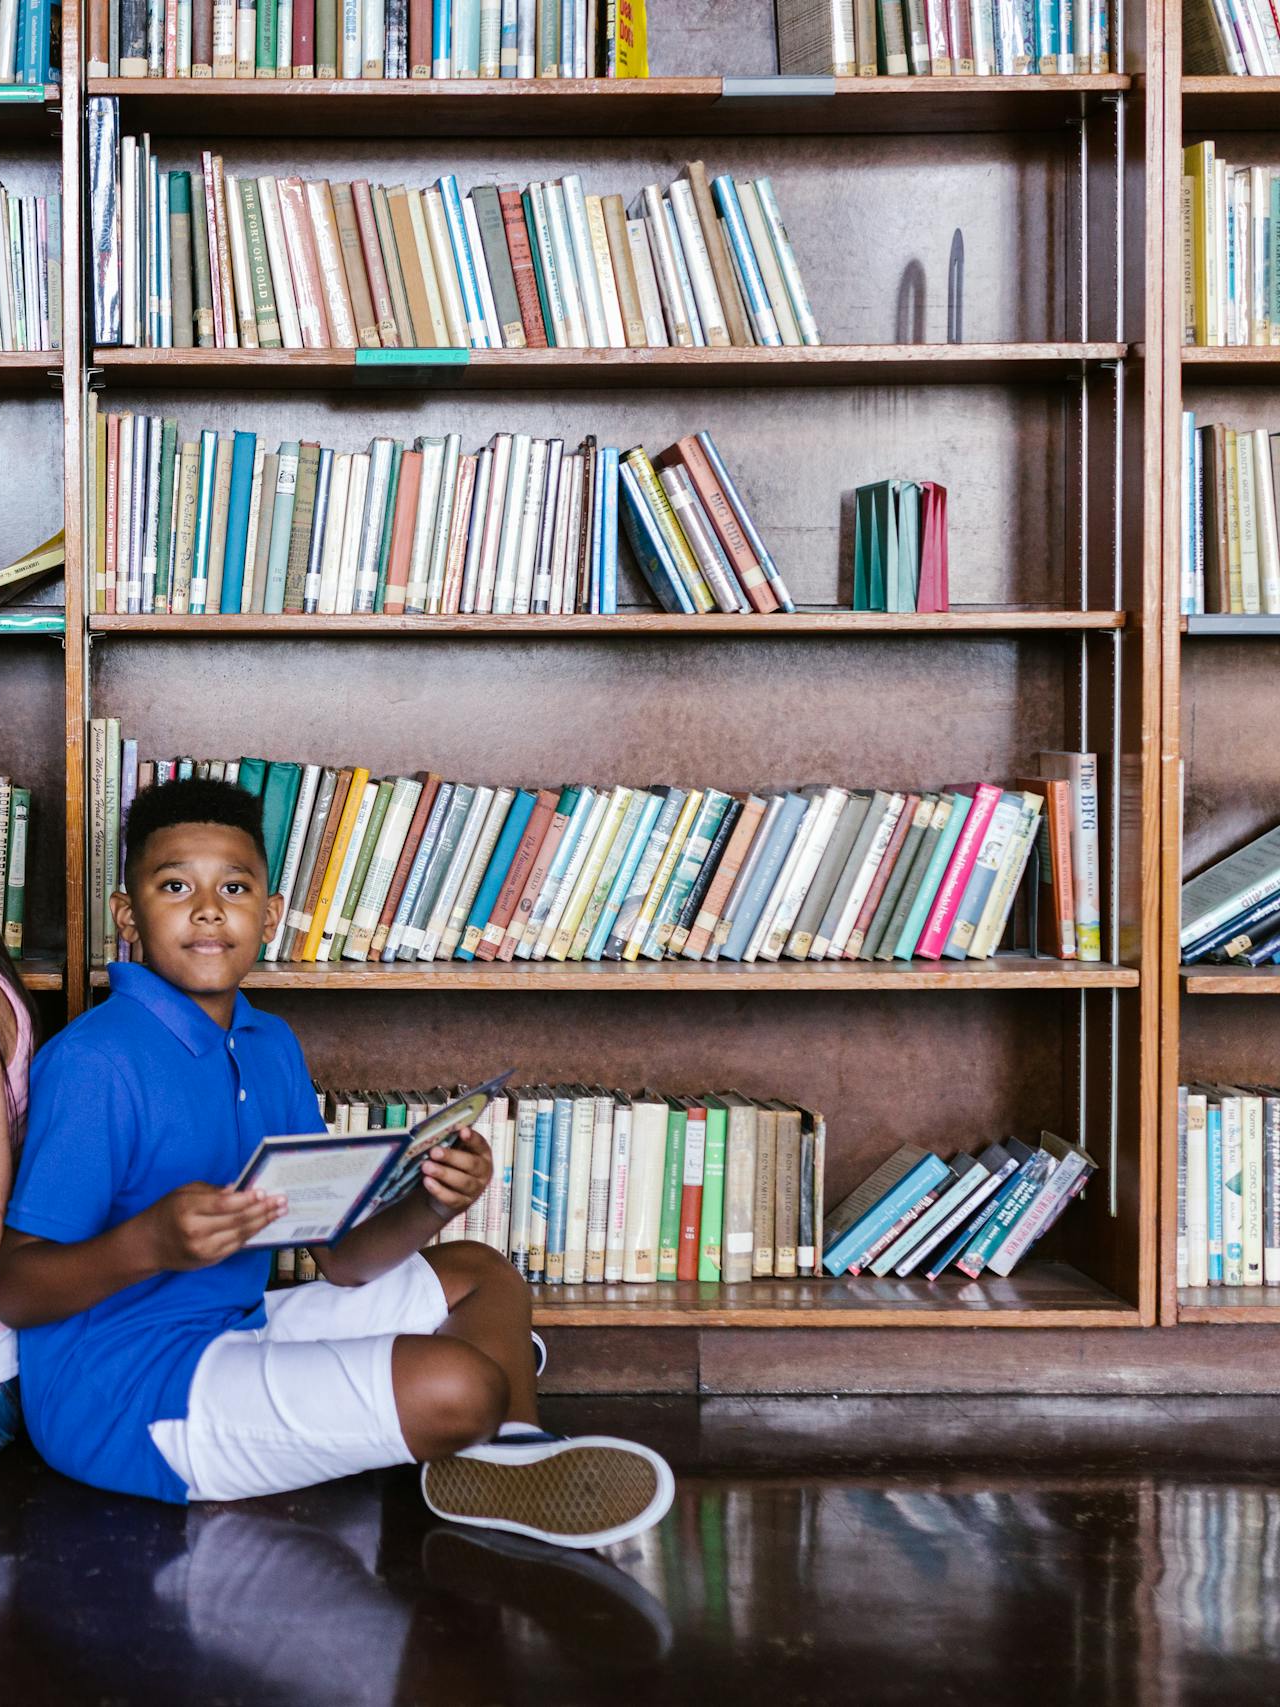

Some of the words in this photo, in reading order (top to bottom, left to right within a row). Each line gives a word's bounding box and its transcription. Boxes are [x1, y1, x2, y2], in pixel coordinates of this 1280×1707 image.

[243, 185, 254, 209] THE
[248, 213, 259, 243] FORT
[252, 247, 262, 262] OF
[255, 266, 267, 298] GOLD
[183, 464, 196, 490] First
[181, 493, 194, 527] Orchid
[1243, 505, 1249, 518] TO
[709, 490, 731, 518] BIG
[720, 520, 745, 556] RIDE
[1243, 520, 1251, 540] WAR
[180, 531, 191, 544] for
[178, 547, 190, 569] Pat
[92, 728, 104, 752] Justin
[92, 757, 104, 794] Morgan
[1080, 761, 1094, 790] The
[92, 799, 104, 818] Had
[1081, 795, 1095, 830] BFG
[92, 830, 104, 856] Horse
[419, 835, 433, 854] THE
[405, 855, 427, 899] MIDNIGHT
[529, 867, 542, 890] FIELD
[398, 900, 413, 925] HORS
[558, 1106, 570, 1114] A
[555, 1117, 570, 1156] Trumpet
[553, 1161, 568, 1196] Sounds
